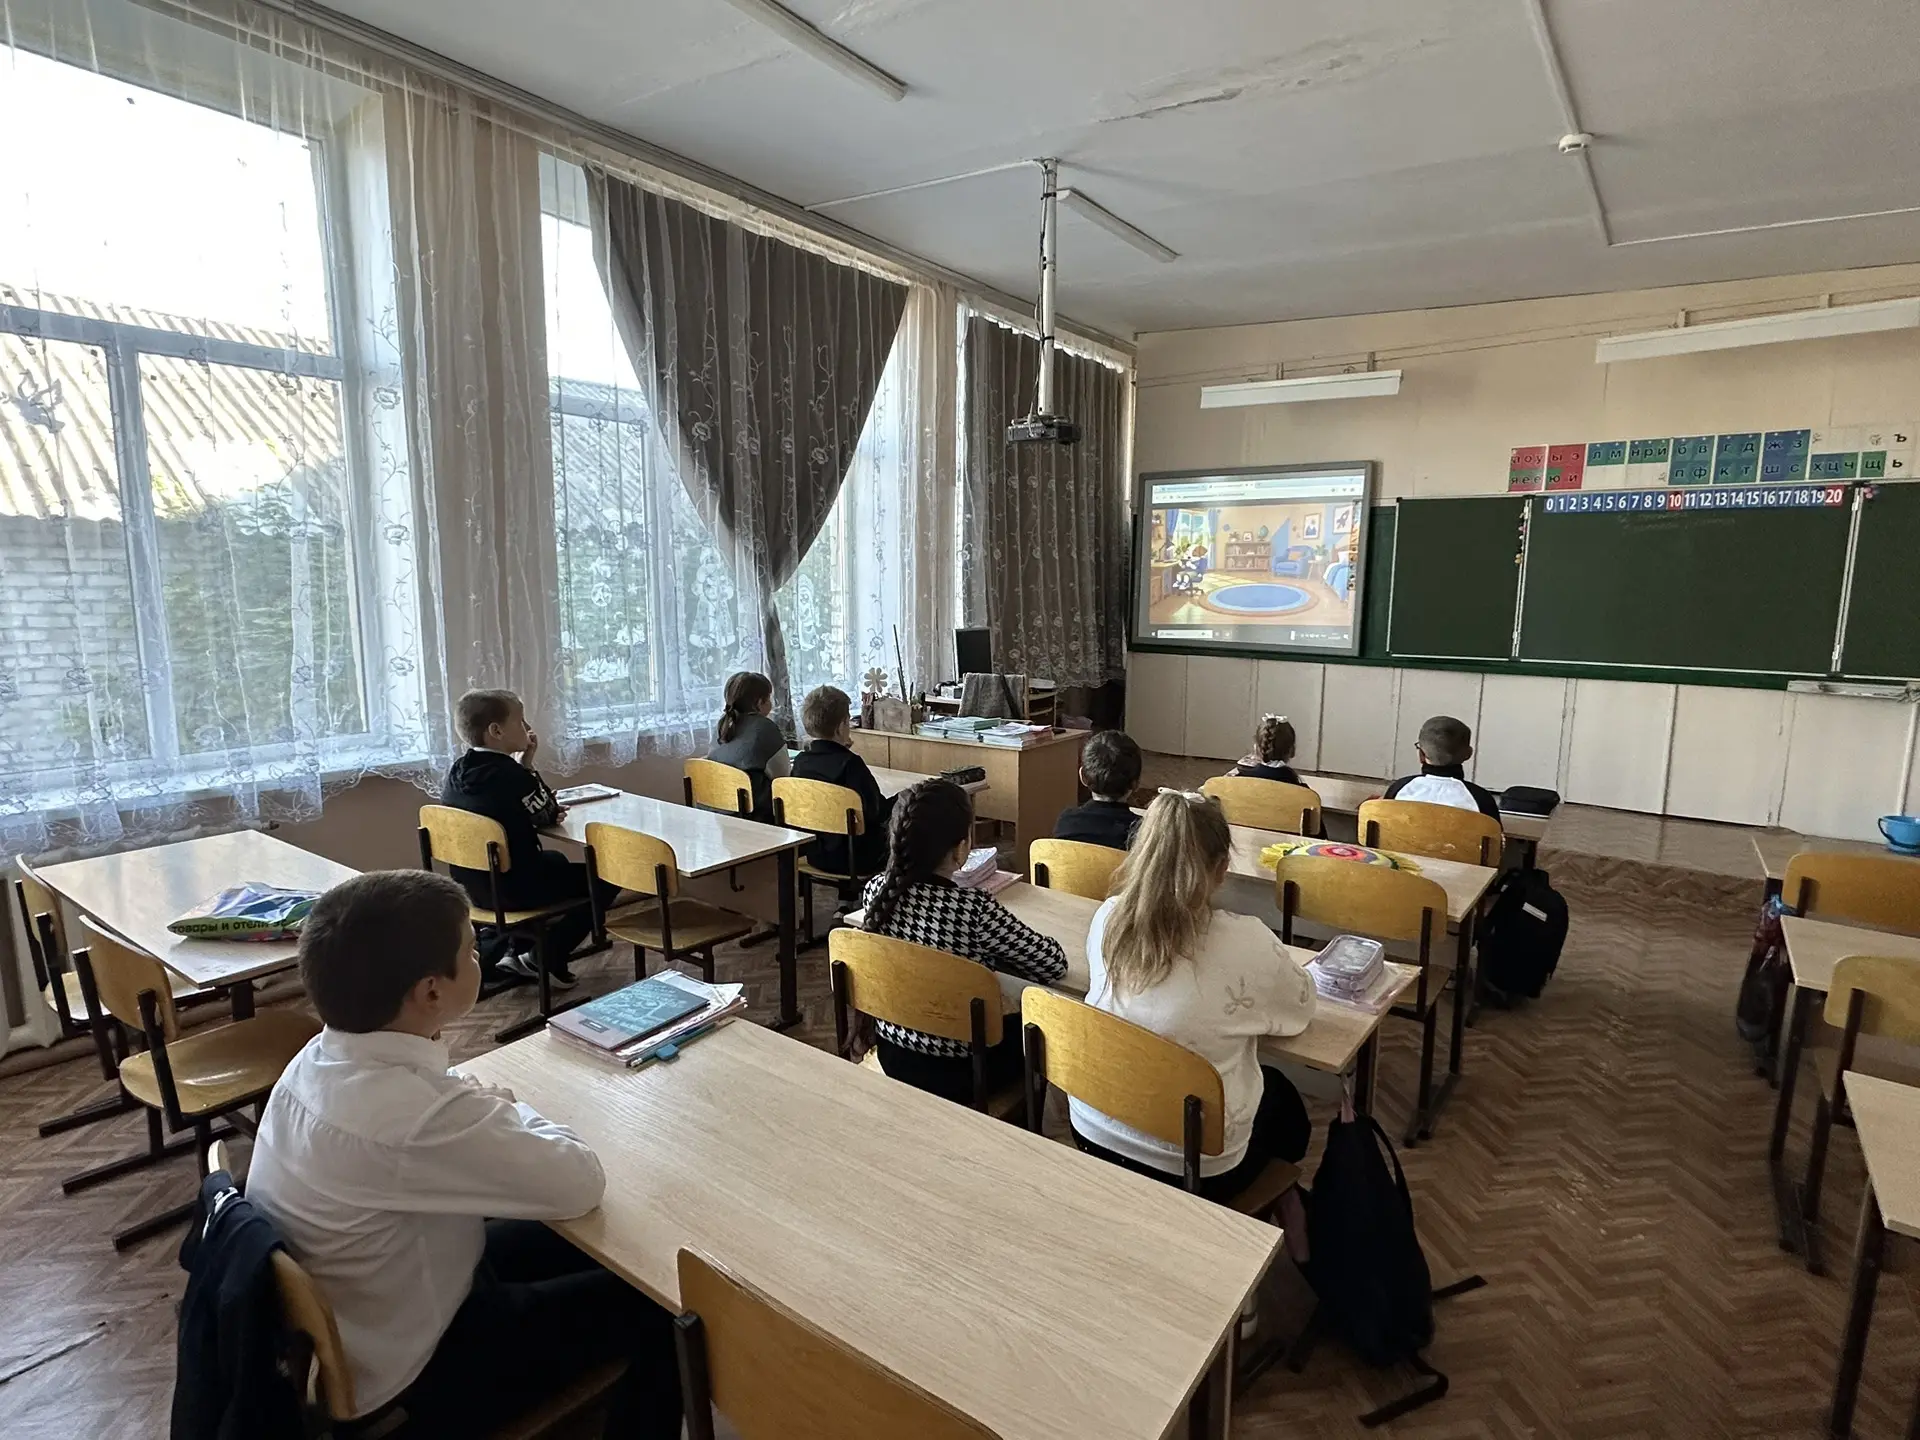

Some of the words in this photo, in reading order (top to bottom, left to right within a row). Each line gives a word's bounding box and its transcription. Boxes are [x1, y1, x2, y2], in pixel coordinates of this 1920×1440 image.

[1895, 434, 1907, 443] ъ
[1694, 467, 1707, 478] ф
[1765, 465, 1779, 474] ш
[1892, 459, 1902, 468] ь
[1546, 498, 1554, 511] 0
[1569, 497, 1577, 510] 2
[1582, 497, 1589, 510] 3
[1593, 497, 1601, 509] 4
[1606, 496, 1614, 509] 5
[1618, 496, 1627, 508] 6
[1632, 495, 1639, 508] 7
[1644, 495, 1652, 508] 8
[1657, 494, 1665, 507] 9
[1670, 494, 1681, 507] 10
[1684, 493, 1696, 506] 11
[1699, 492, 1712, 506] 12
[1714, 492, 1727, 505] 13
[1730, 492, 1743, 505] 14
[1746, 491, 1759, 505] 15
[1762, 491, 1775, 504] 16
[1778, 490, 1792, 504] 17
[1794, 490, 1808, 504] 18
[1810, 489, 1824, 503] 19
[1825, 489, 1842, 503] 20
[173, 924, 218, 934] товары
[233, 921, 268, 929] отели
